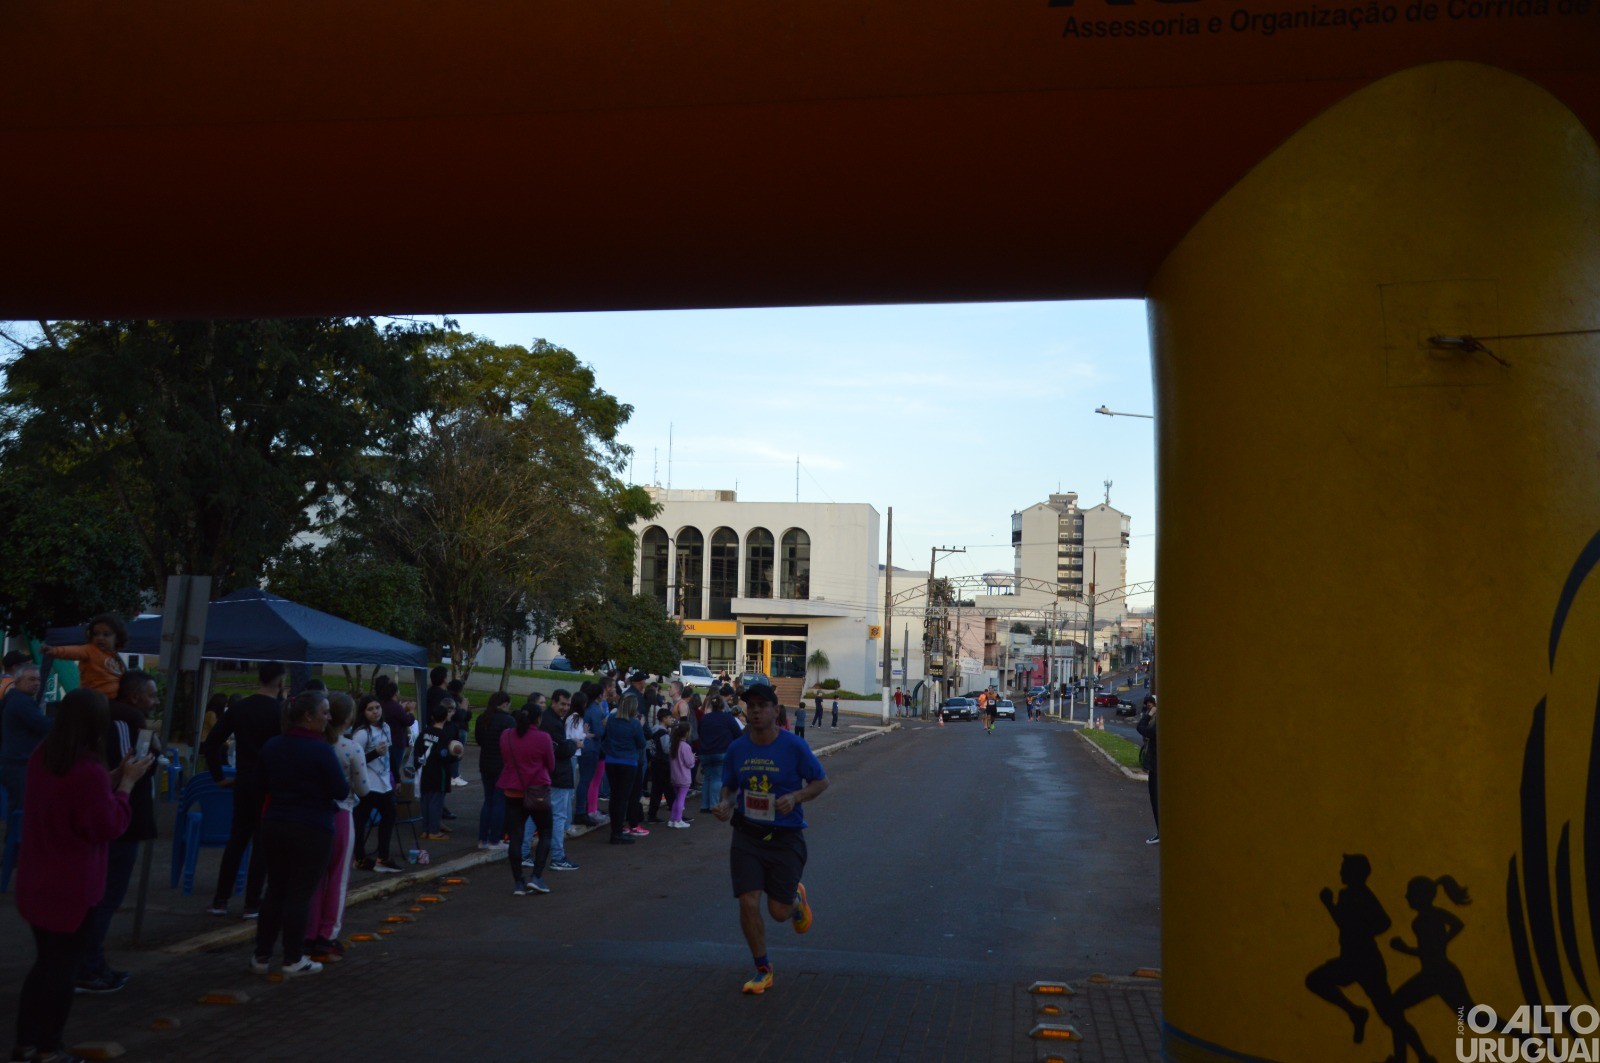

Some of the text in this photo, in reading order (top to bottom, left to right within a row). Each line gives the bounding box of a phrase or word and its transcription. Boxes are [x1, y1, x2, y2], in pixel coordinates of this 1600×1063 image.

[1062, 0, 1592, 38] Assessoria e Organização de Corrida de
